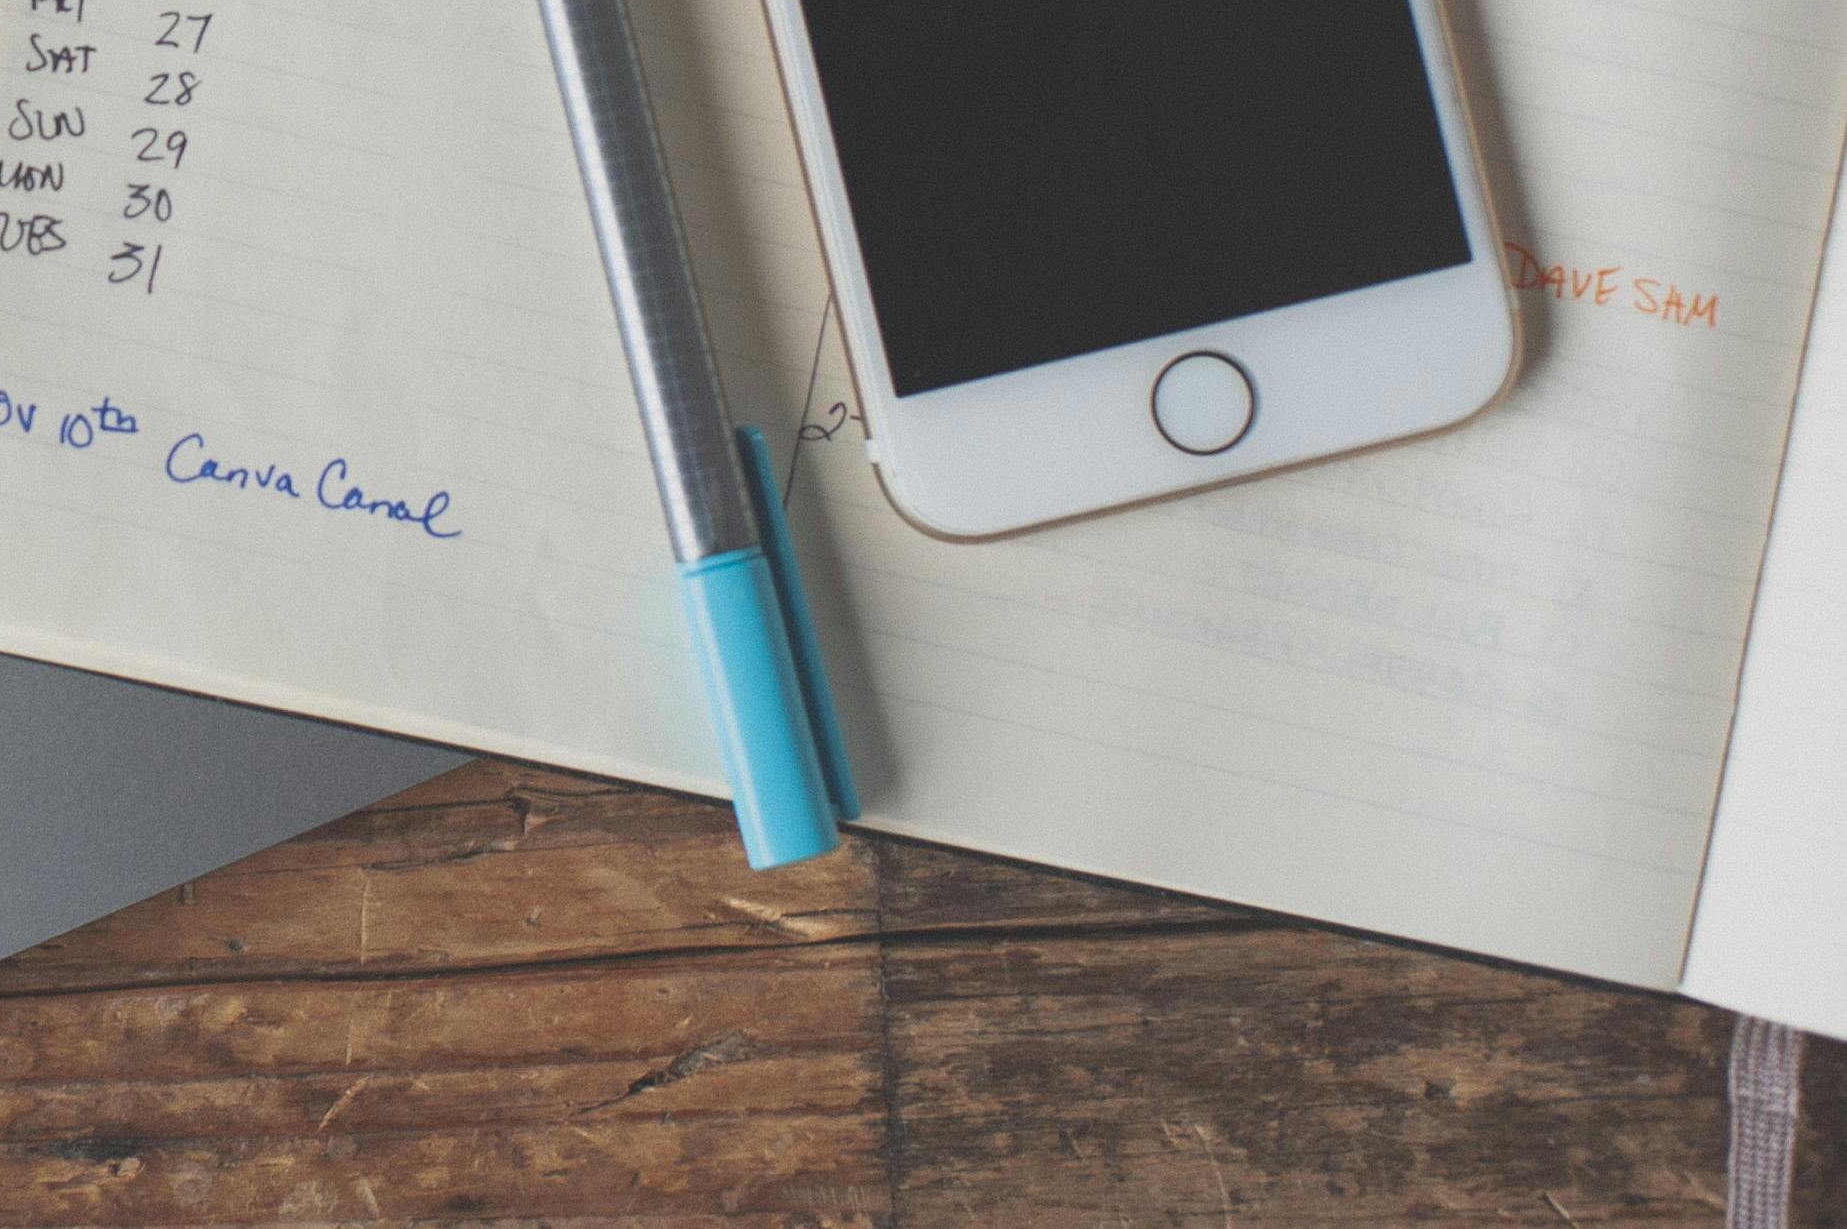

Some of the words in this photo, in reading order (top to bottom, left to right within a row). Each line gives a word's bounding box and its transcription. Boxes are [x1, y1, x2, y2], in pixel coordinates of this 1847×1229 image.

[155, 10, 213, 54] 27
[25, 34, 97, 74] SAT
[144, 72, 202, 107] 28
[8, 99, 86, 141] SUN
[131, 127, 188, 170] 29
[123, 182, 173, 222] 30
[107, 242, 162, 295] 31
[1504, 241, 1623, 307] DAVE
[1633, 277, 1720, 329] SAM
[164, 433, 301, 499] Canva
